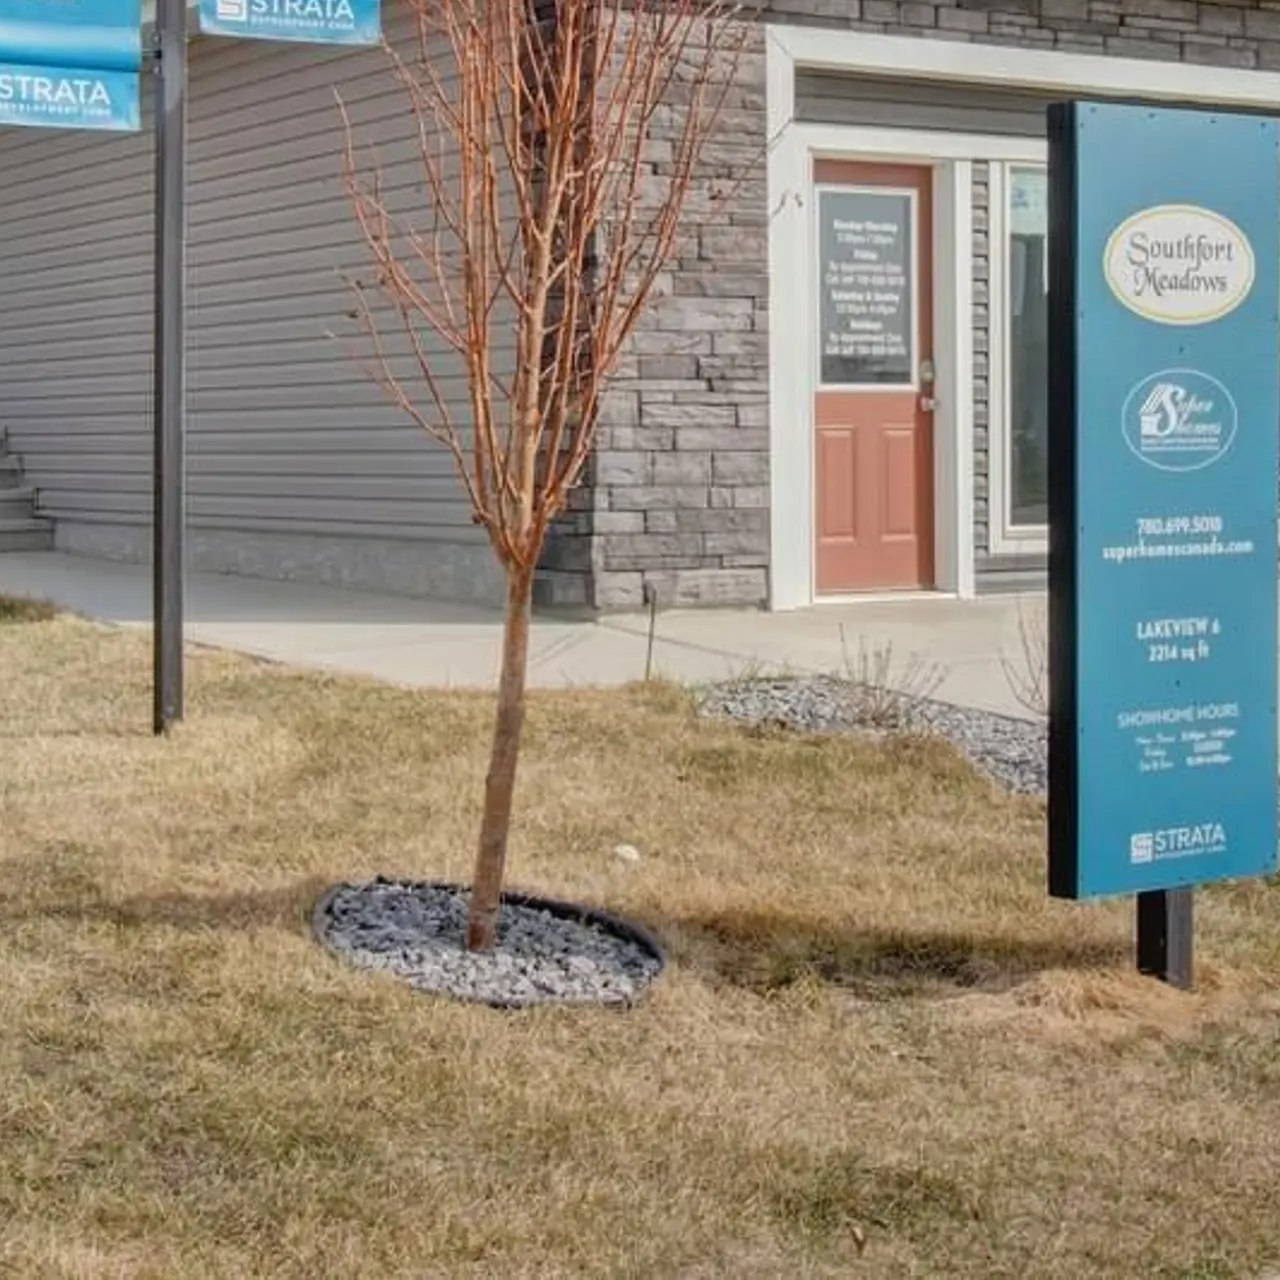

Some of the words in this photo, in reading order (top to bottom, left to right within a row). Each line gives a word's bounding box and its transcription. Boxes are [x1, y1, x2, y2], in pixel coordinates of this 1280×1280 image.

[1126, 231, 1234, 272] Southfort
[1134, 267, 1227, 296] Meadows
[1136, 618, 1208, 640] LAKEVIEW
[1148, 644, 1178, 662] 2214
[1155, 823, 1226, 852] STRATA
